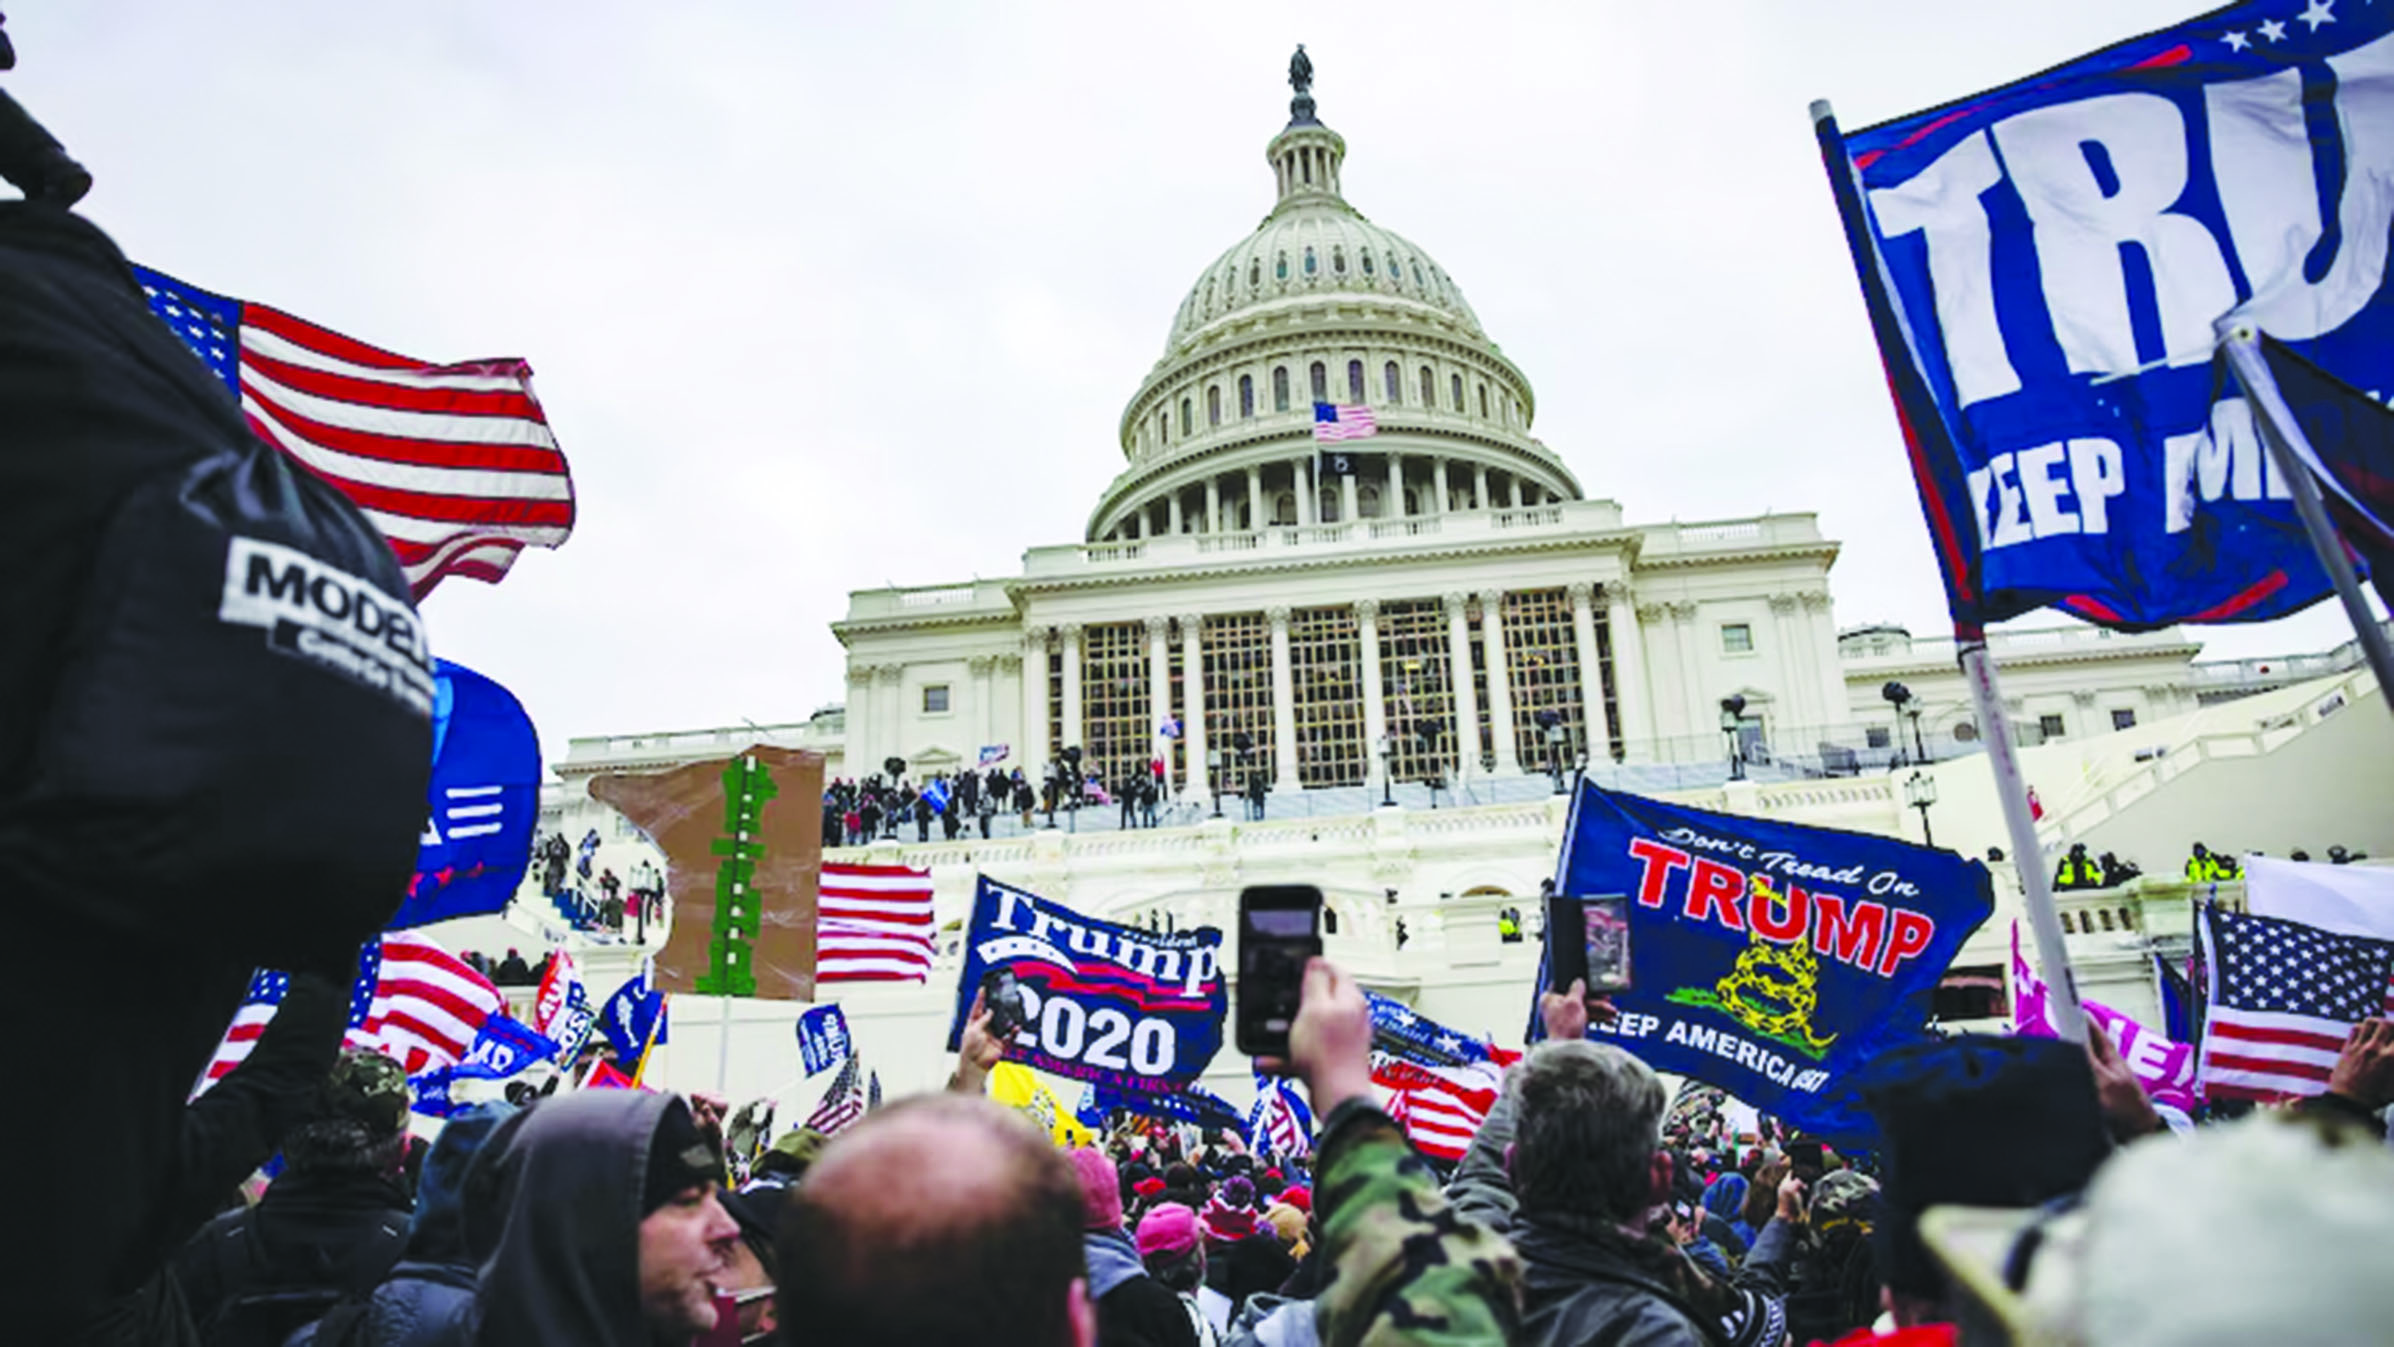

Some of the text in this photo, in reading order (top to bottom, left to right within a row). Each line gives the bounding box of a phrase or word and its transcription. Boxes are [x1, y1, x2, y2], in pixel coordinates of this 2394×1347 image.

[1658, 827, 1756, 859] Don't
[1759, 851, 1920, 897] Tread On
[986, 882, 1218, 998] Trump
[1628, 837, 1935, 978] TRUMP
[1588, 1011, 1660, 1037] EEP
[1664, 1019, 1796, 1088] AMERICA
